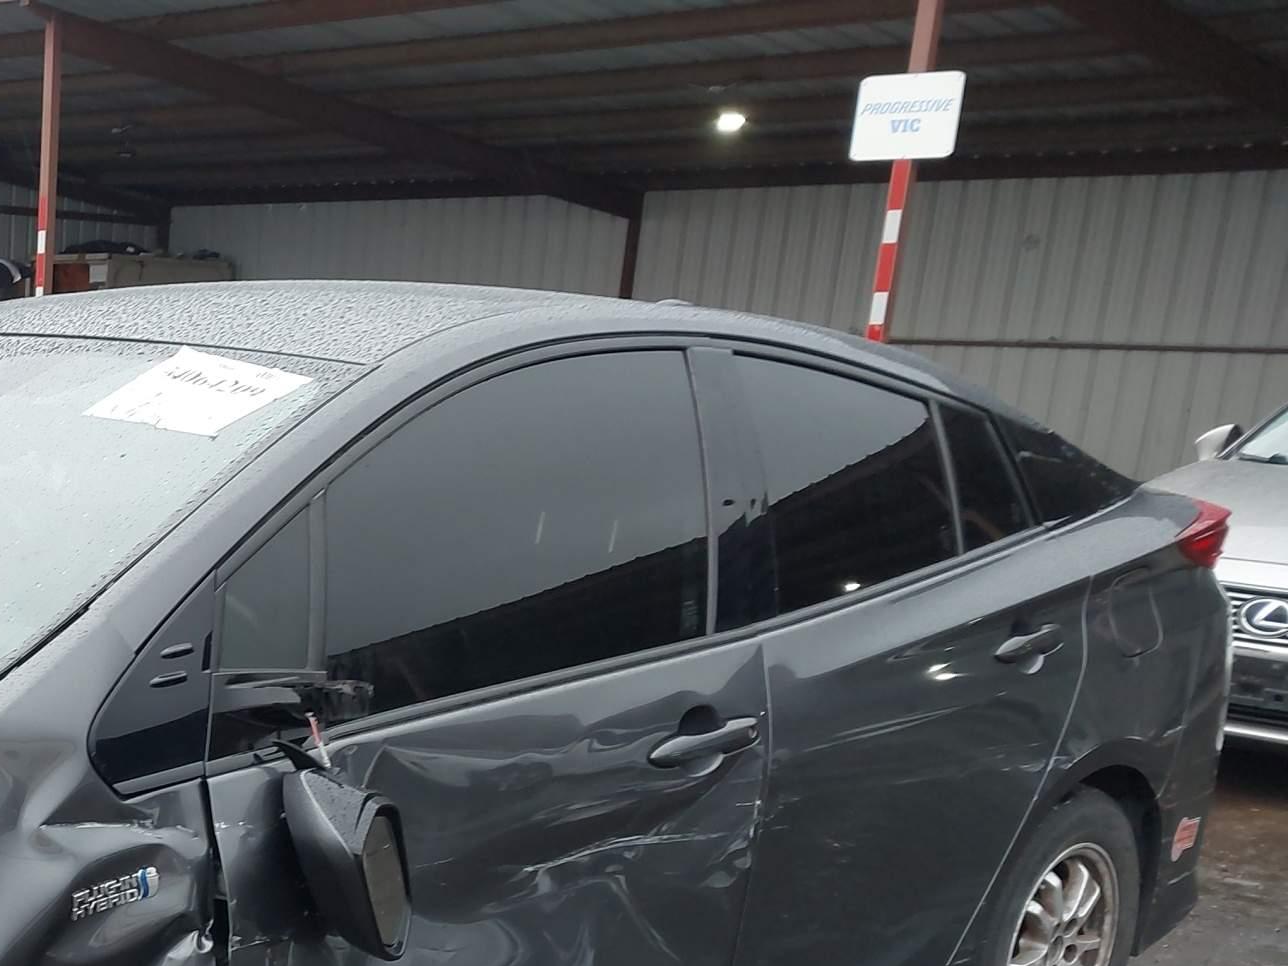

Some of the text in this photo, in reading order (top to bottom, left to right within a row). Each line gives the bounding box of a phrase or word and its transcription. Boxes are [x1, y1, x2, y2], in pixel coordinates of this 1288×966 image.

[861, 98, 954, 115] PROGRESSIVE
[890, 118, 921, 134] VIC
[72, 888, 139, 921] HYBRID
